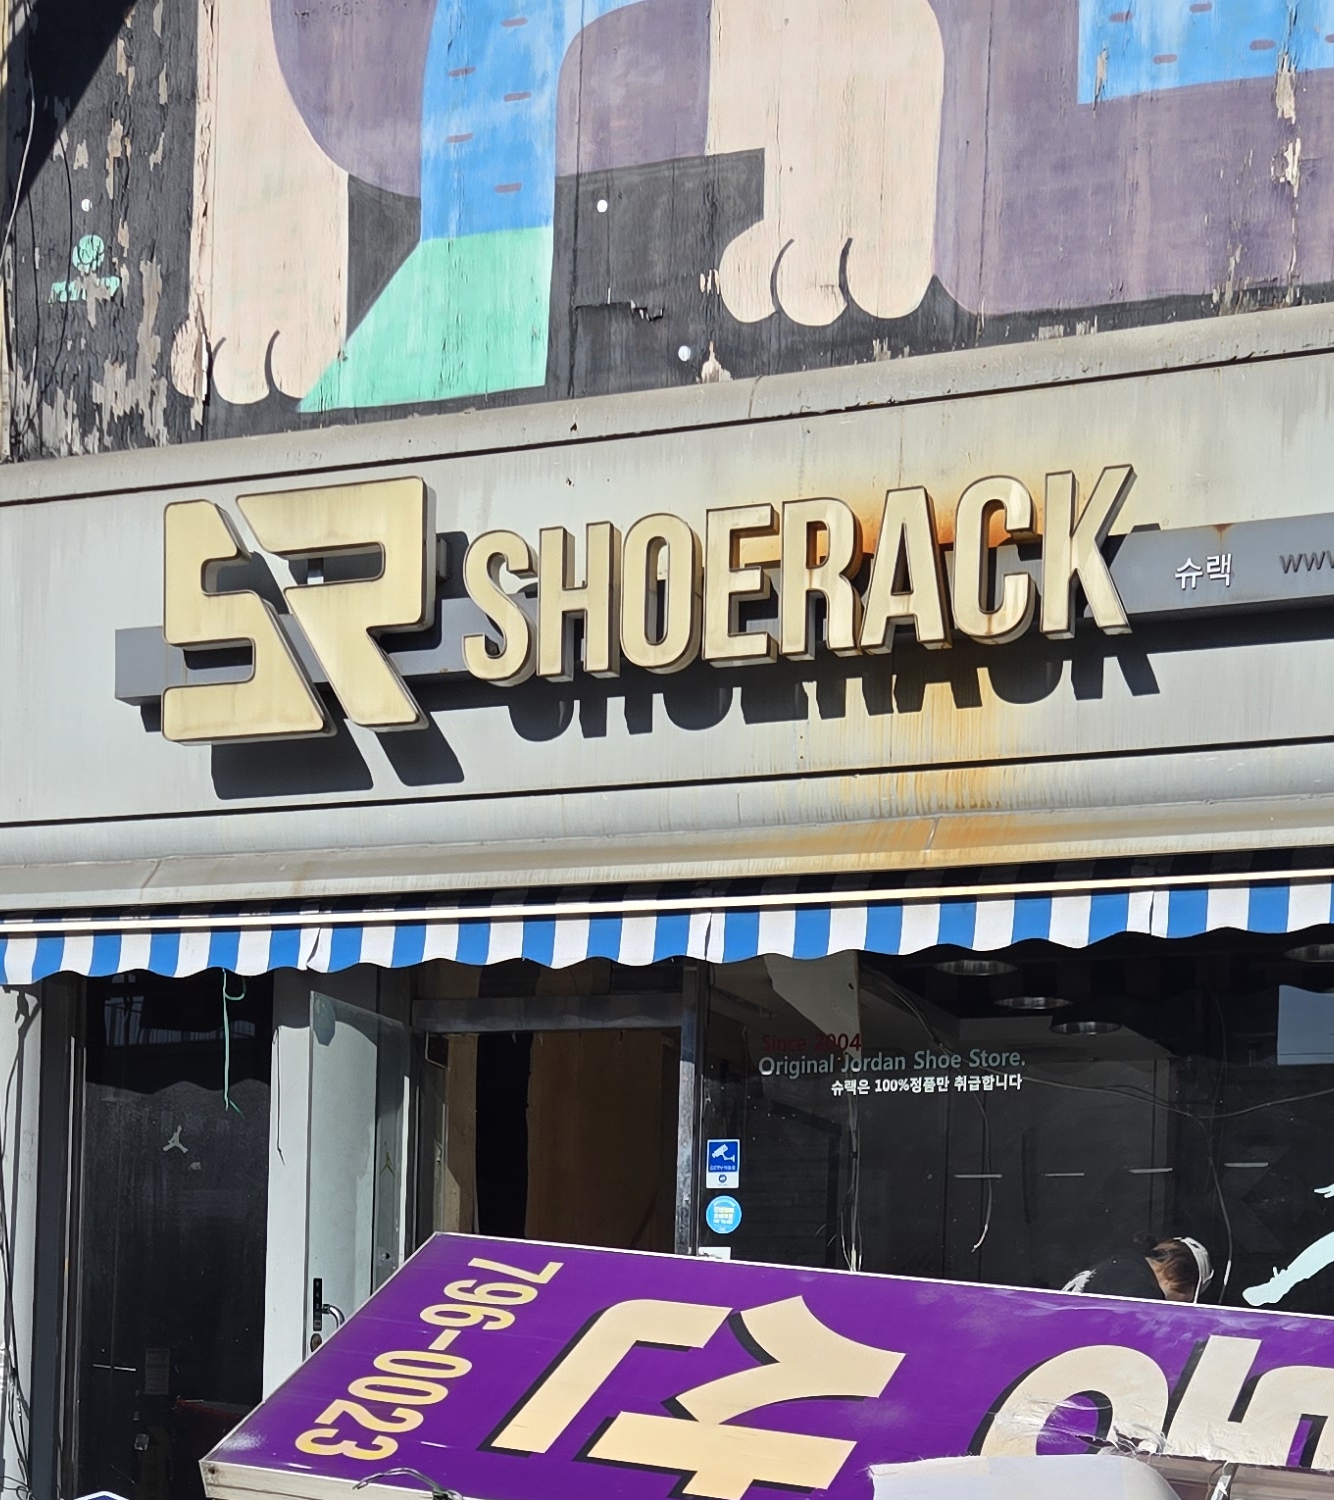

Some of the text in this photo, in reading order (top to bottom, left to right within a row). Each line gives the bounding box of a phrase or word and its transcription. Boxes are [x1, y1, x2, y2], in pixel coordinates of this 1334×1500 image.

[463, 465, 1137, 688] SHOERACK
[1174, 553, 1233, 590] 슈랙
[762, 1033, 862, 1052] Since 2004
[758, 1048, 1026, 1079] Original Jordan Shoe Store.
[874, 1075, 949, 1094] 100%정품만
[954, 1073, 1023, 1092] 취급합니다
[296, 1256, 562, 1461] 796-0023
